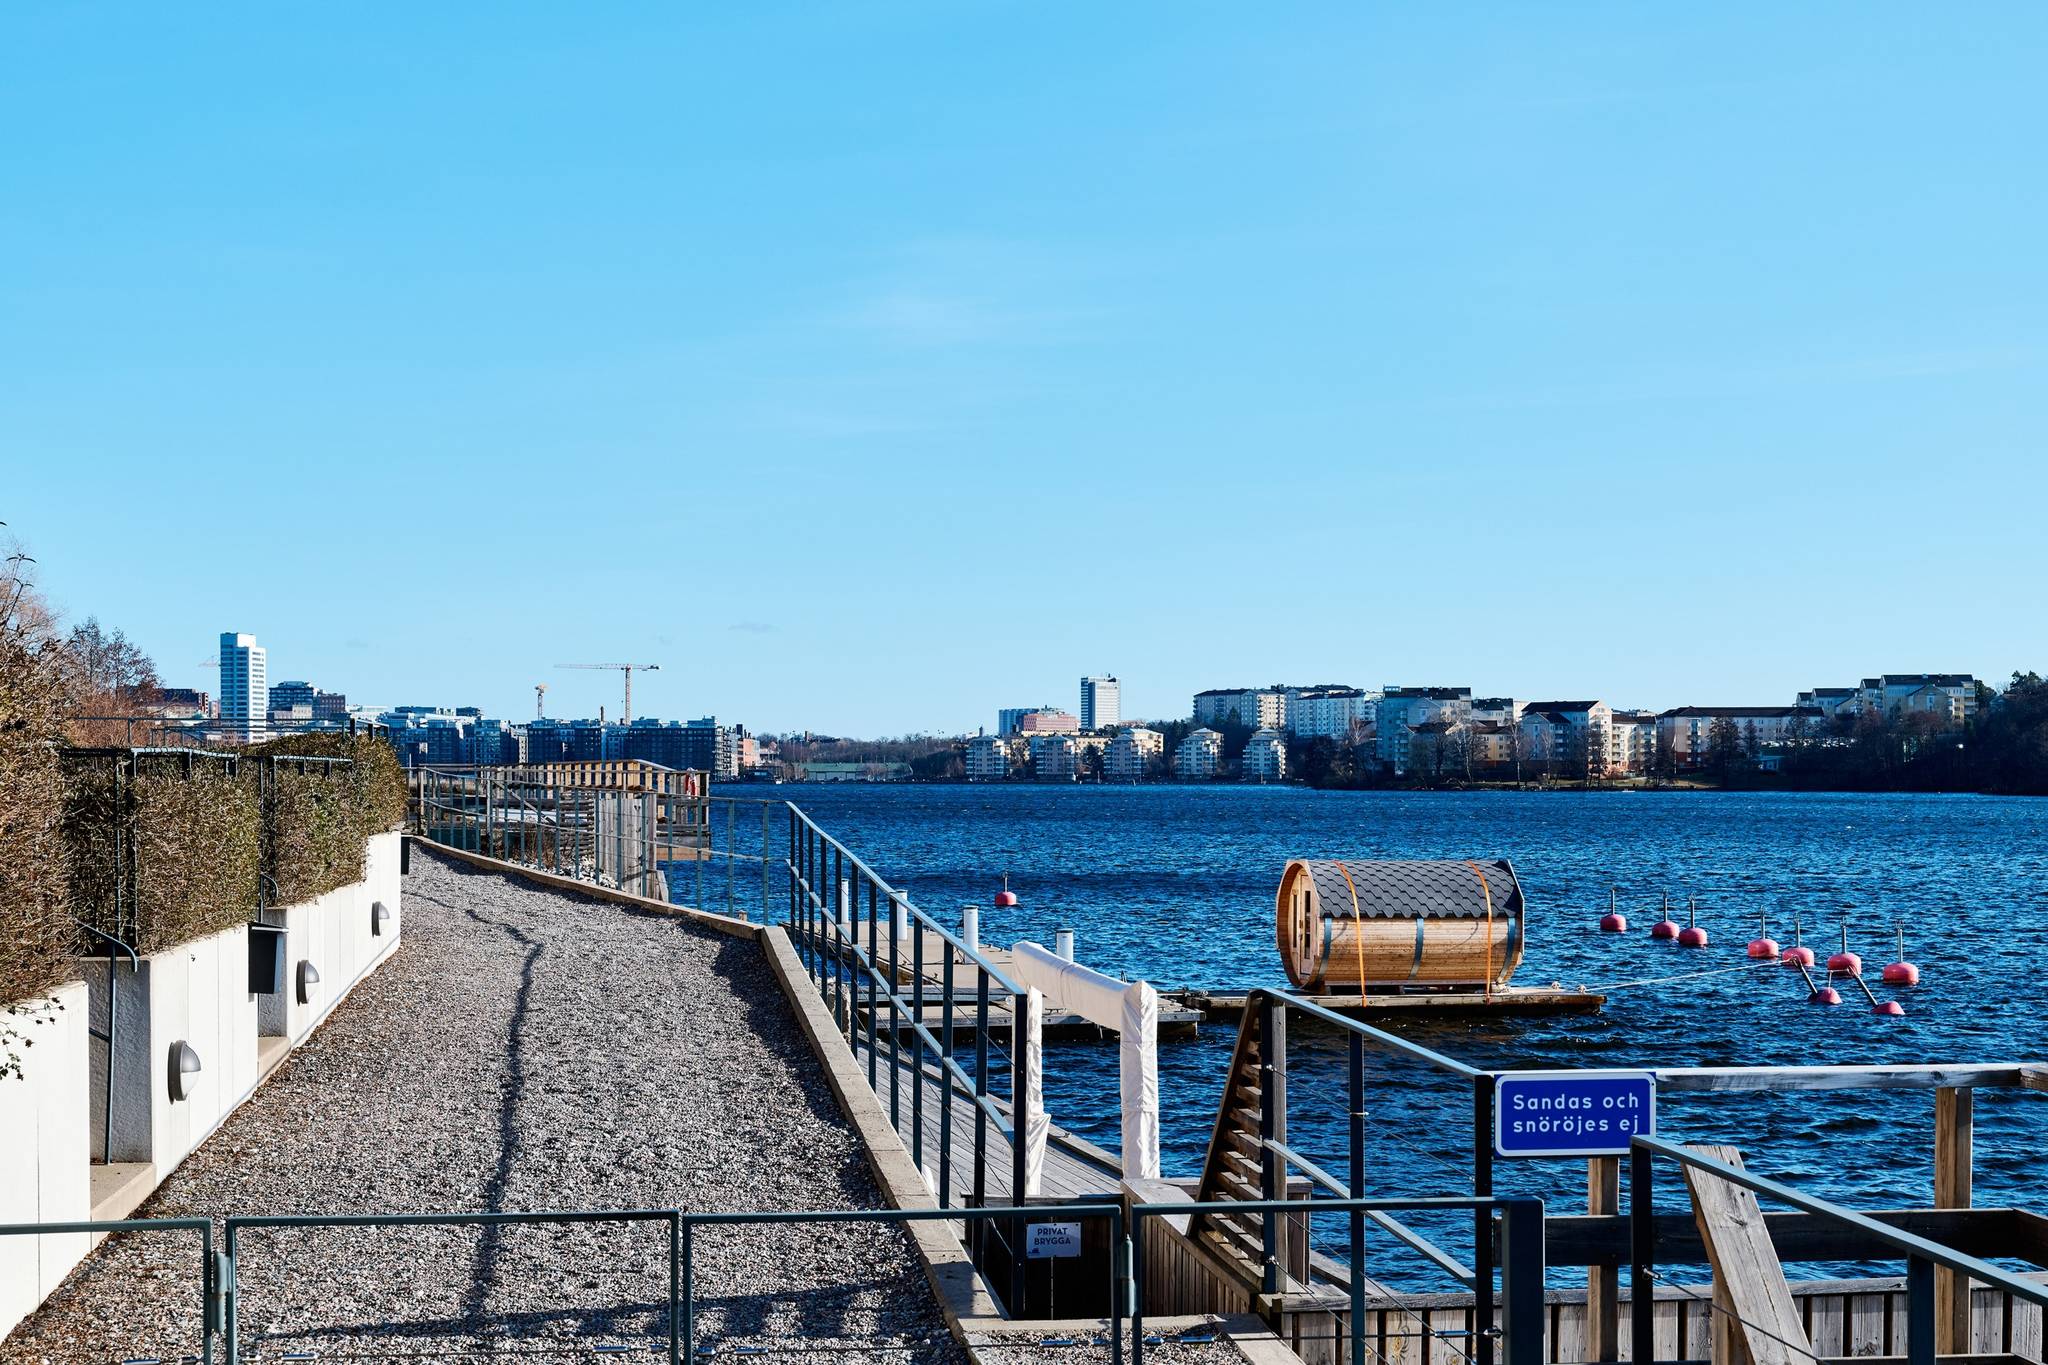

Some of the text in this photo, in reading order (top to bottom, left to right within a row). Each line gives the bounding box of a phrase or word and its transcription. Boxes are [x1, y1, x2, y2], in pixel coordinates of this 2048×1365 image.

[1513, 1092, 1639, 1110] Sandas och
[1513, 1114, 1639, 1135] snöröjes ej
[1037, 1227, 1068, 1236] PRIVAT
[1034, 1237, 1071, 1246] BRYGGA
